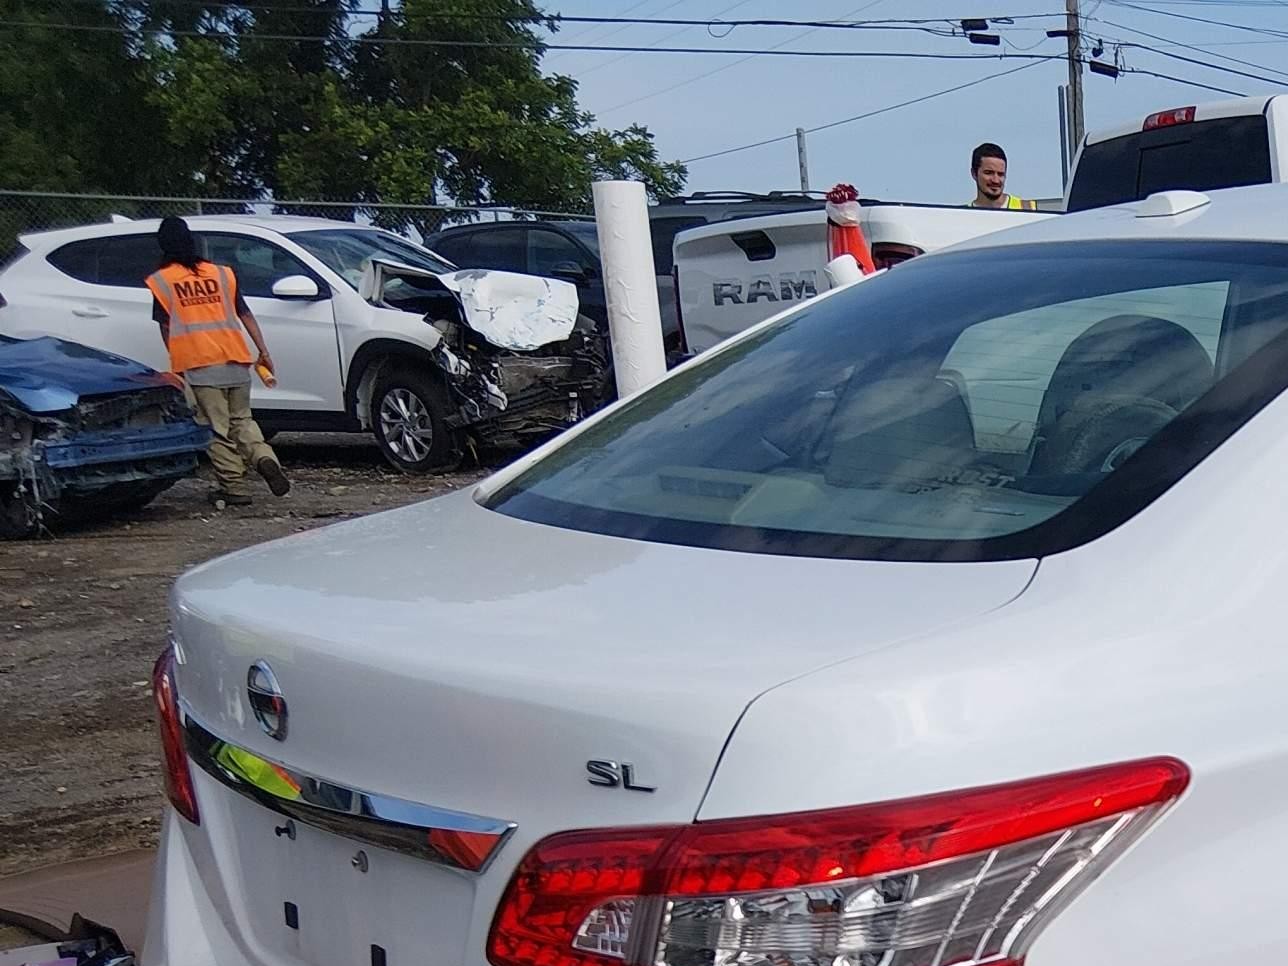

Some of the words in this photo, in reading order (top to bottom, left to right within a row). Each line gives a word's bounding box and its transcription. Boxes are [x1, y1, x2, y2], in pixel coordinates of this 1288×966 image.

[173, 278, 220, 299] MAD
[713, 270, 818, 306] RAM
[586, 759, 658, 793] SL
